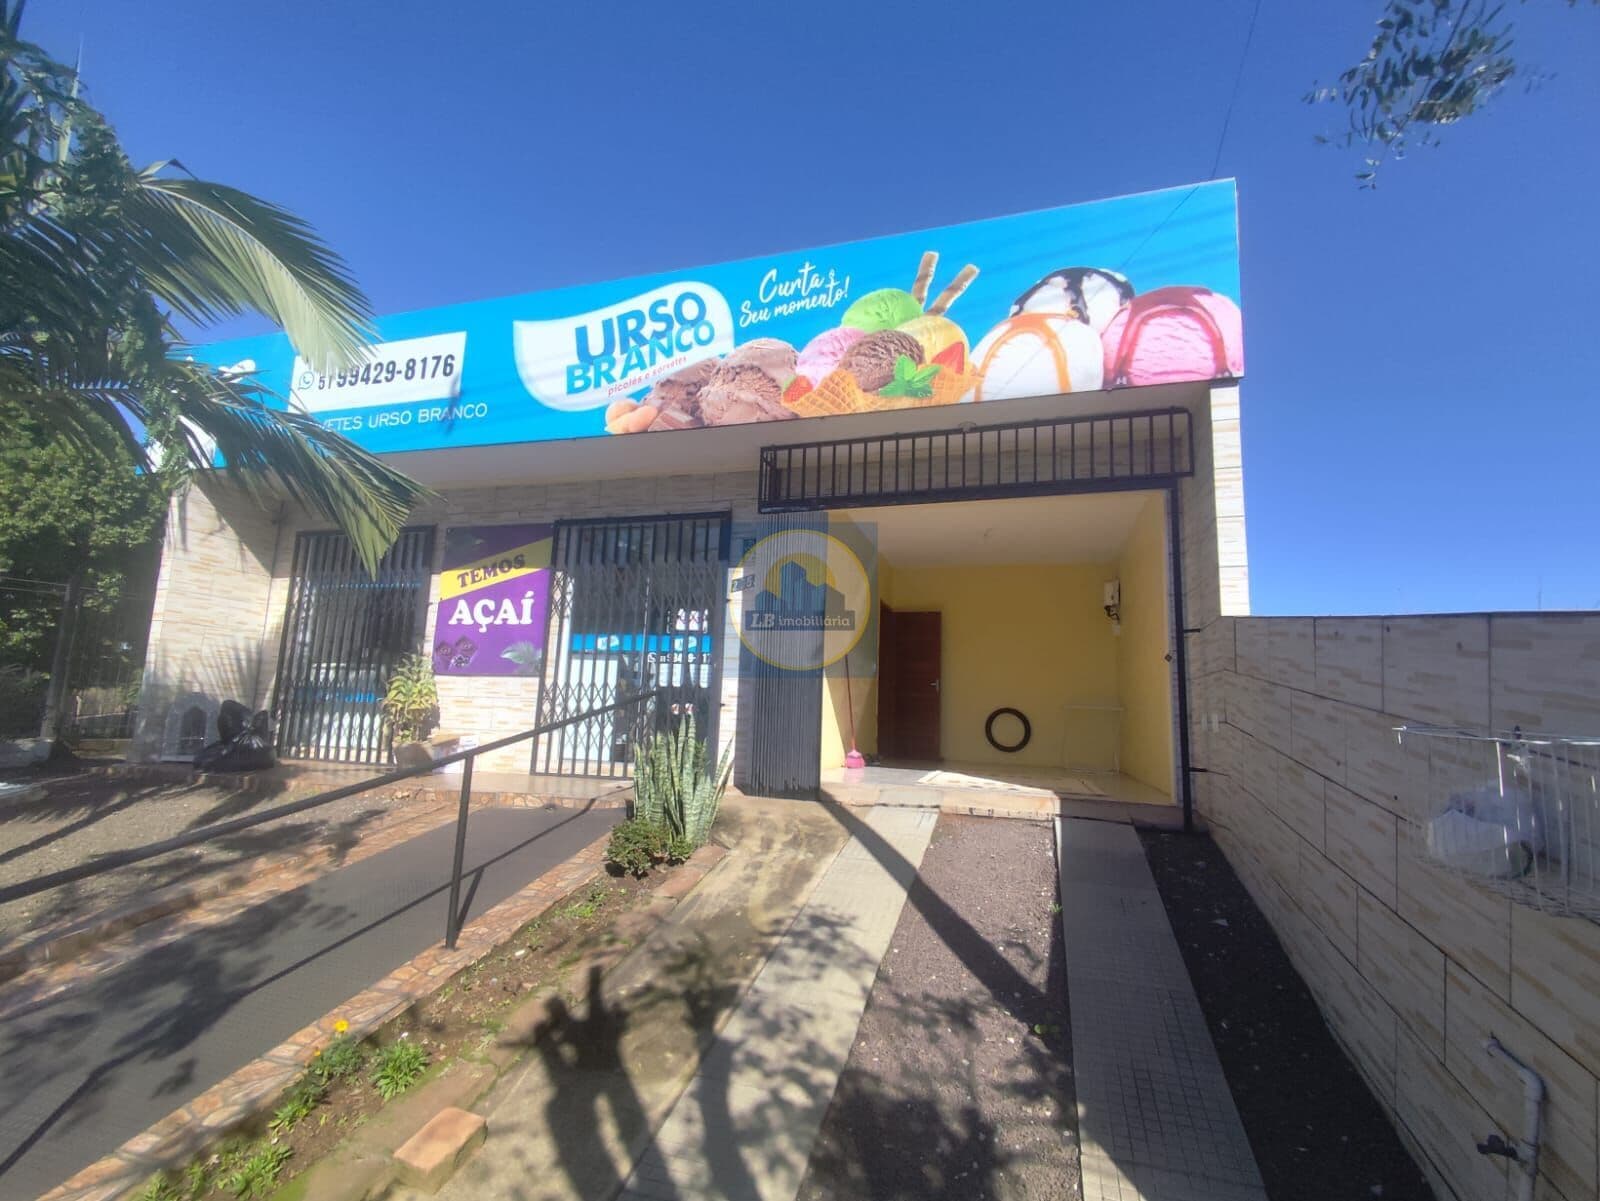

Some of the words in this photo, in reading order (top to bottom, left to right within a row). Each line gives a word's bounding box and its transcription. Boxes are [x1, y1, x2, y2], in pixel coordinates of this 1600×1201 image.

[739, 300, 771, 328] Seu
[774, 275, 850, 317] momento!
[759, 262, 825, 303] Curta
[574, 291, 708, 365] URSO
[337, 354, 456, 388] 99429-8176
[565, 319, 715, 395] BRANCO
[368, 410, 412, 428] URSO
[418, 402, 488, 424] BRANCO
[457, 554, 526, 589] TEMOS
[448, 591, 535, 633] AÇAÍ
